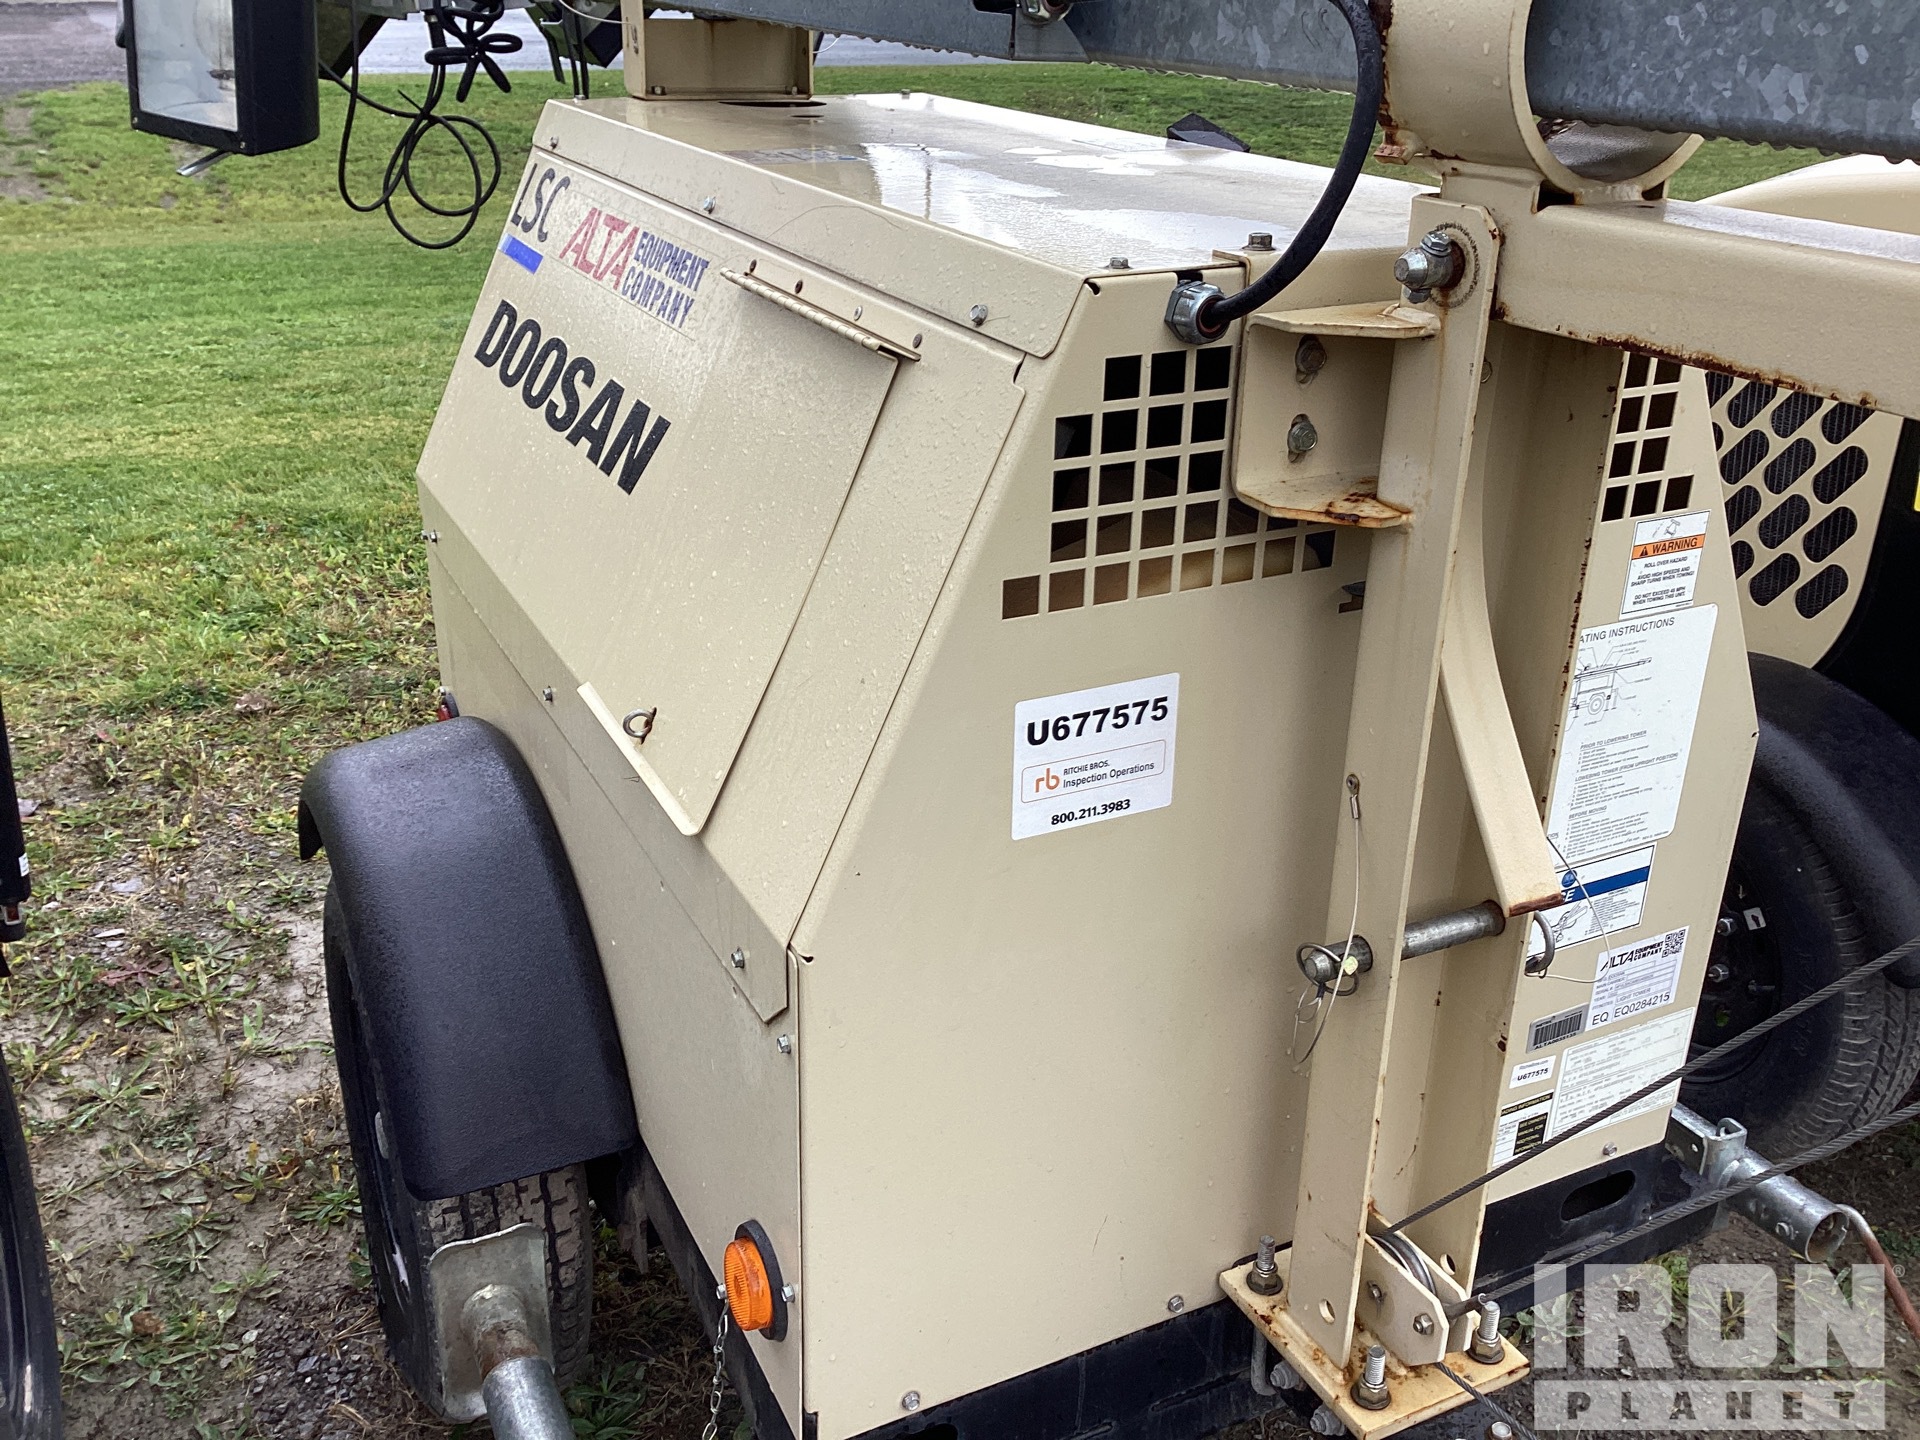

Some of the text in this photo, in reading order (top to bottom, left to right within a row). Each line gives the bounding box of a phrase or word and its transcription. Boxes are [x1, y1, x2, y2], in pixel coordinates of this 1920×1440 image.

[511, 163, 570, 242] LSC
[559, 207, 640, 290] ALTA
[634, 231, 710, 292] EQUIPMENT
[621, 267, 695, 328] COMPANY
[474, 299, 672, 495] DOOSAN
[1652, 538, 1697, 554] WARNING
[1579, 617, 1675, 643] ATING INSTRUCTIONS
[1027, 696, 1168, 746] U677575
[1035, 768, 1060, 793] rb
[1063, 760, 1110, 776] RITCHIE BROS.
[1063, 762, 1155, 788] Inspection Operations
[1051, 798, 1131, 825] 800.211.3983
[1600, 950, 1634, 971] ALTA
[1634, 947, 1662, 961] COMPANY
[1635, 941, 1664, 954] EQUIPMENT
[1592, 1011, 1609, 1025] EQ
[1614, 991, 1670, 1018] EQ0284215
[1517, 1068, 1549, 1081] U677575
